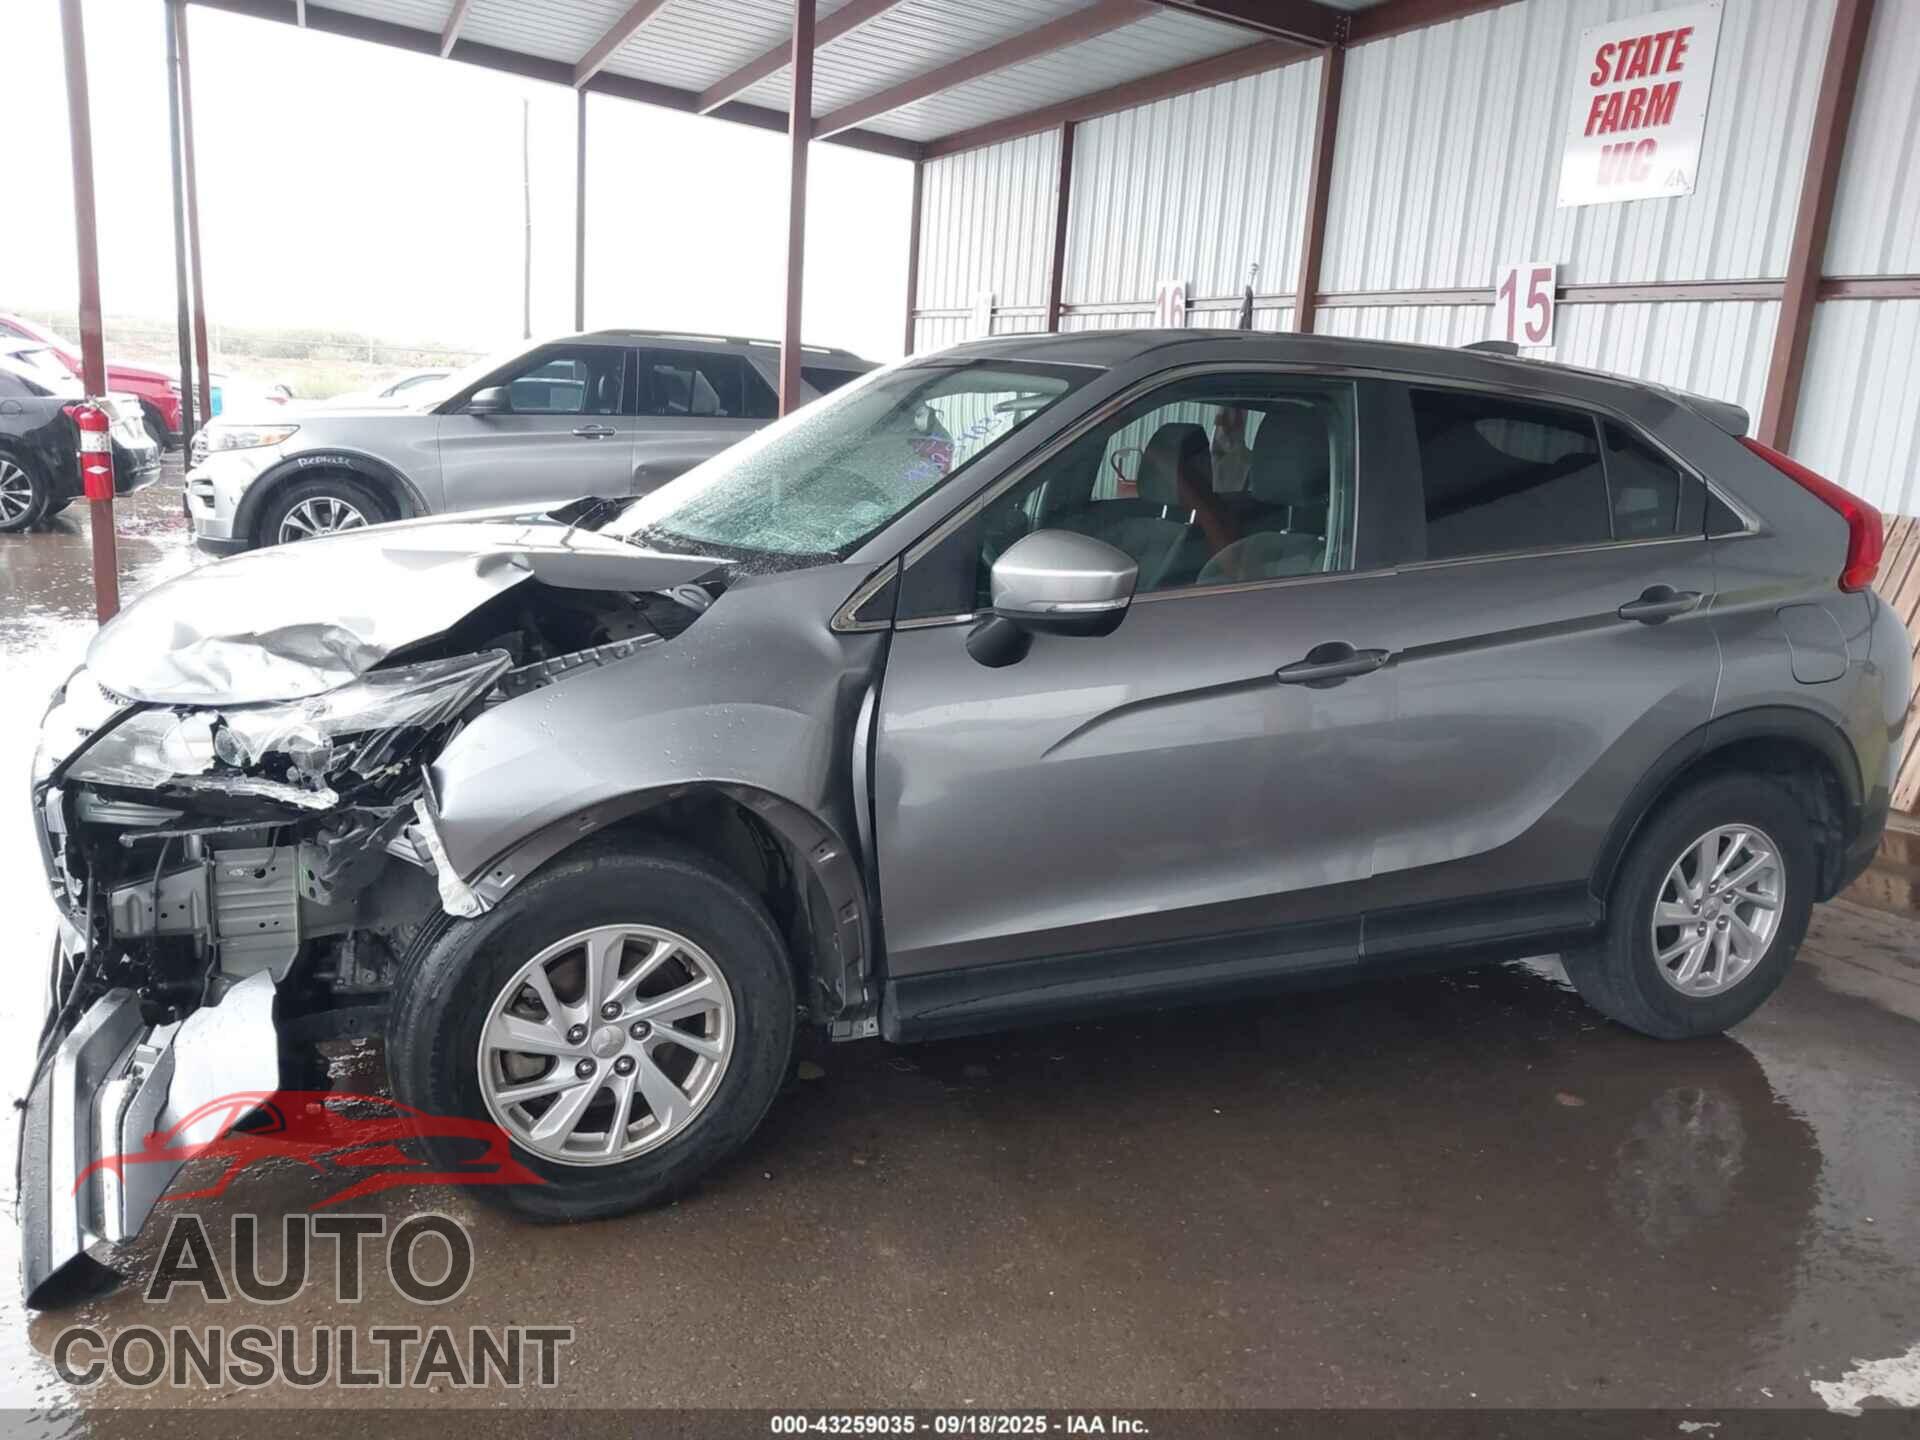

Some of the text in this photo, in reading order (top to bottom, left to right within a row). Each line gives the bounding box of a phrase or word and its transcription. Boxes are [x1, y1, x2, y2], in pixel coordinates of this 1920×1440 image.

[1590, 26, 1694, 87] STATE
[1584, 81, 1682, 137] FARM
[1156, 286, 1184, 328] 16
[1499, 267, 1553, 343] 15
